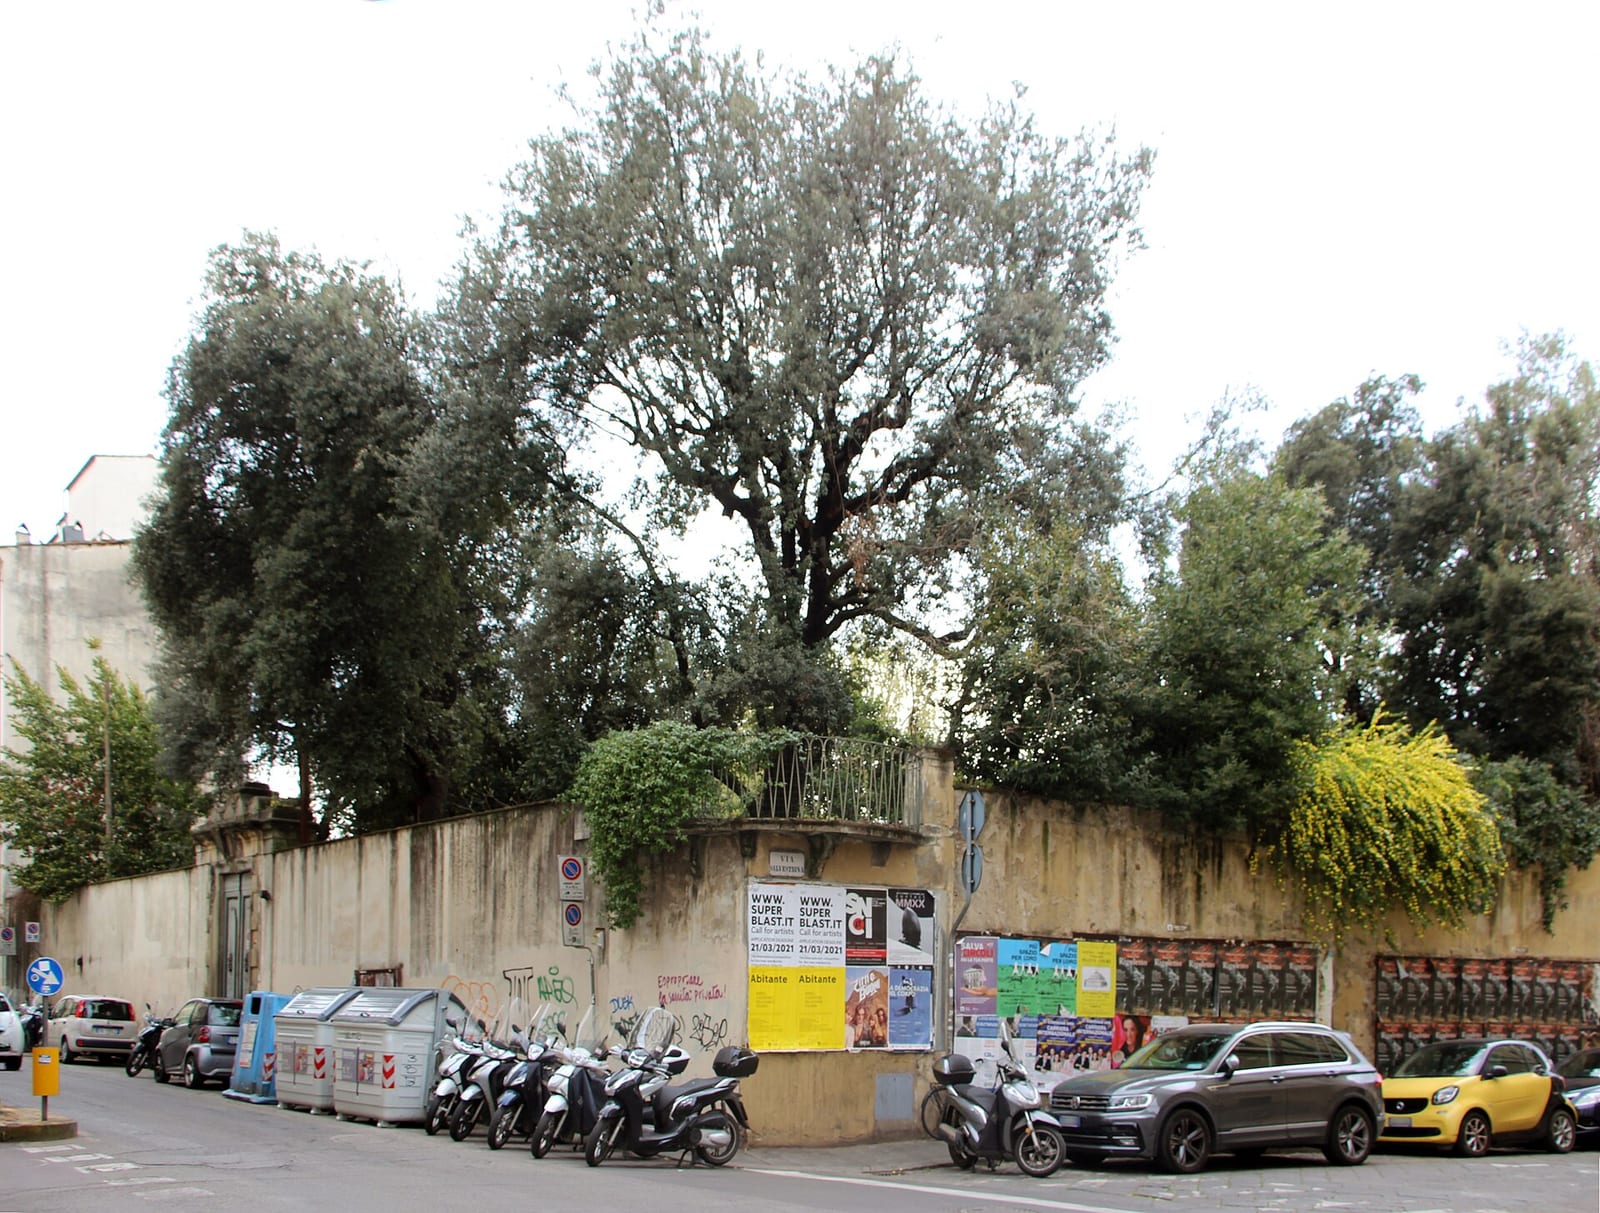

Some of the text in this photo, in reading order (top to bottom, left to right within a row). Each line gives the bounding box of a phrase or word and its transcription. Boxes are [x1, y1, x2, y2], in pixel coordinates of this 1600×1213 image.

[780, 855, 794, 863] VIA
[751, 894, 785, 905] WWW.
[800, 896, 833, 907] WWW.
[896, 899, 925, 908] MMXX
[751, 905, 783, 915] SUPER
[800, 907, 831, 918] SUPER
[751, 916, 794, 927] BLAST.IT
[800, 918, 842, 929] BLAST.IT
[751, 926, 794, 935] Call for artists
[799, 928, 842, 938] Call for artists
[751, 943, 794, 953] 21/03/2021
[799, 945, 843, 955] 21/03/2021
[751, 974, 788, 983] Abitante
[799, 975, 837, 984] Abitante
